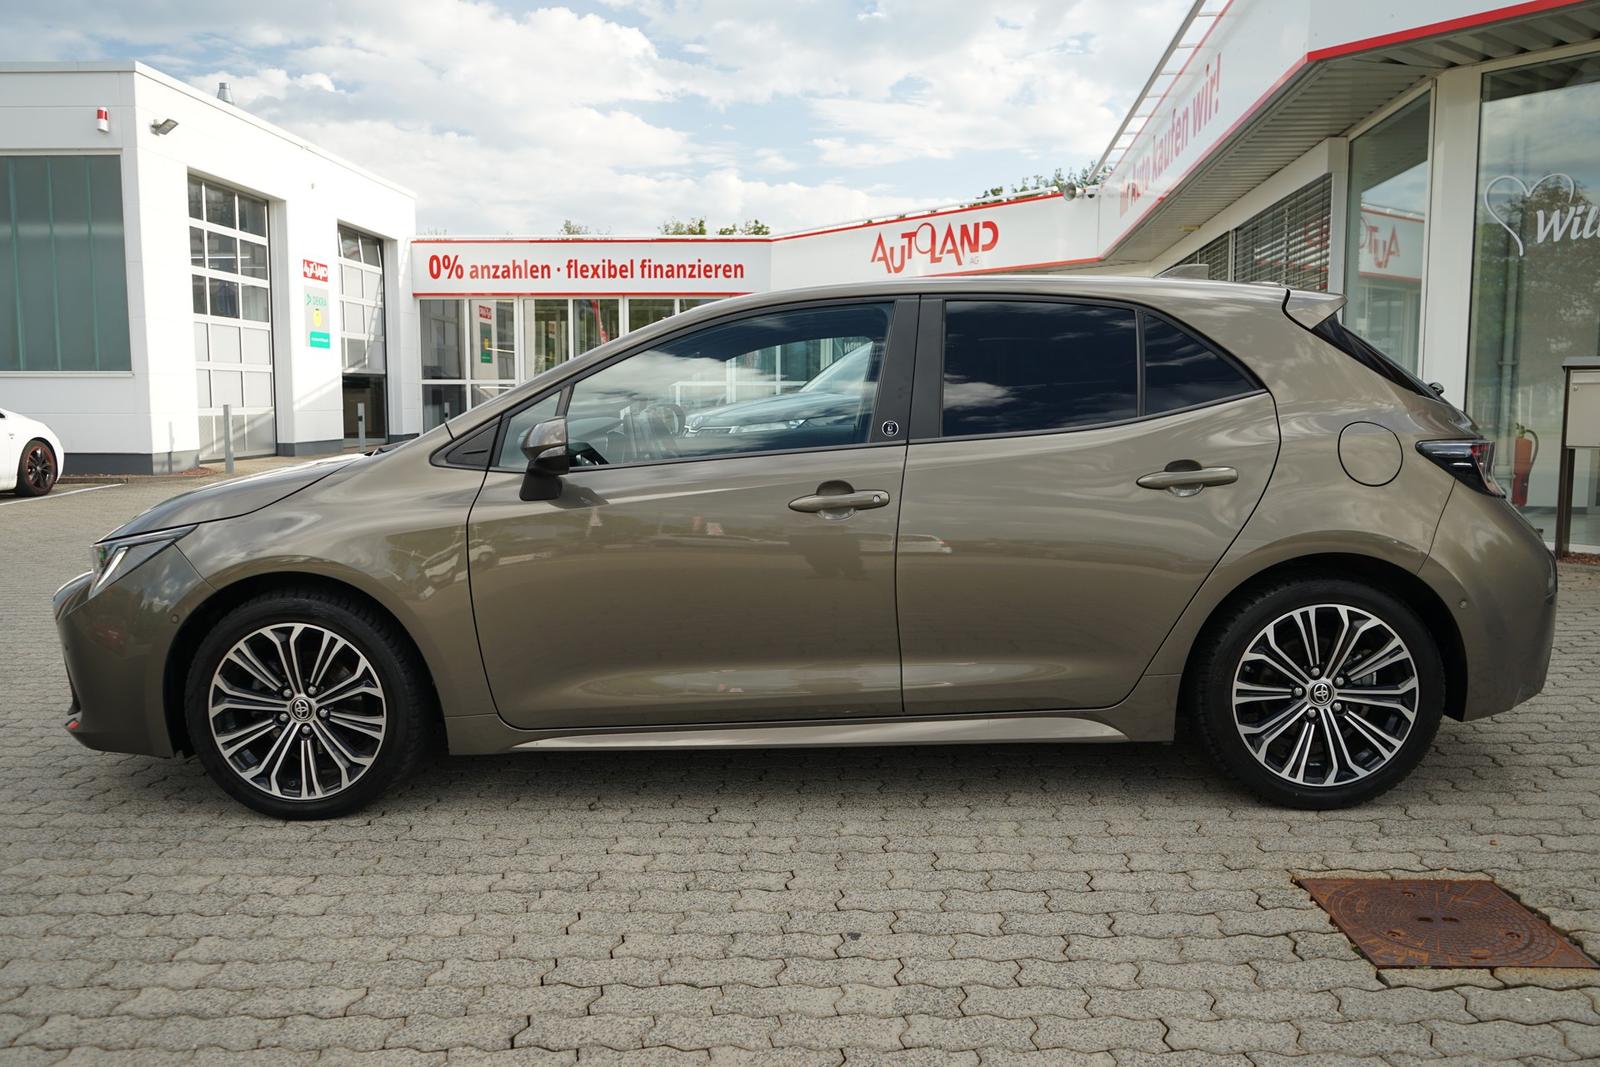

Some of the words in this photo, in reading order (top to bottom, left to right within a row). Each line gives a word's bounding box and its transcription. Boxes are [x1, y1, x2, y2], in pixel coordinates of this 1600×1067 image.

[1152, 107, 1189, 182] kaufen
[1193, 52, 1221, 137] wir!
[871, 220, 999, 273] AUTOLAND
[1536, 205, 1600, 244] Wil
[428, 254, 465, 280] 0%
[469, 259, 552, 280] anzahlen
[566, 259, 635, 280] flexibel
[639, 259, 745, 280] finanzieren
